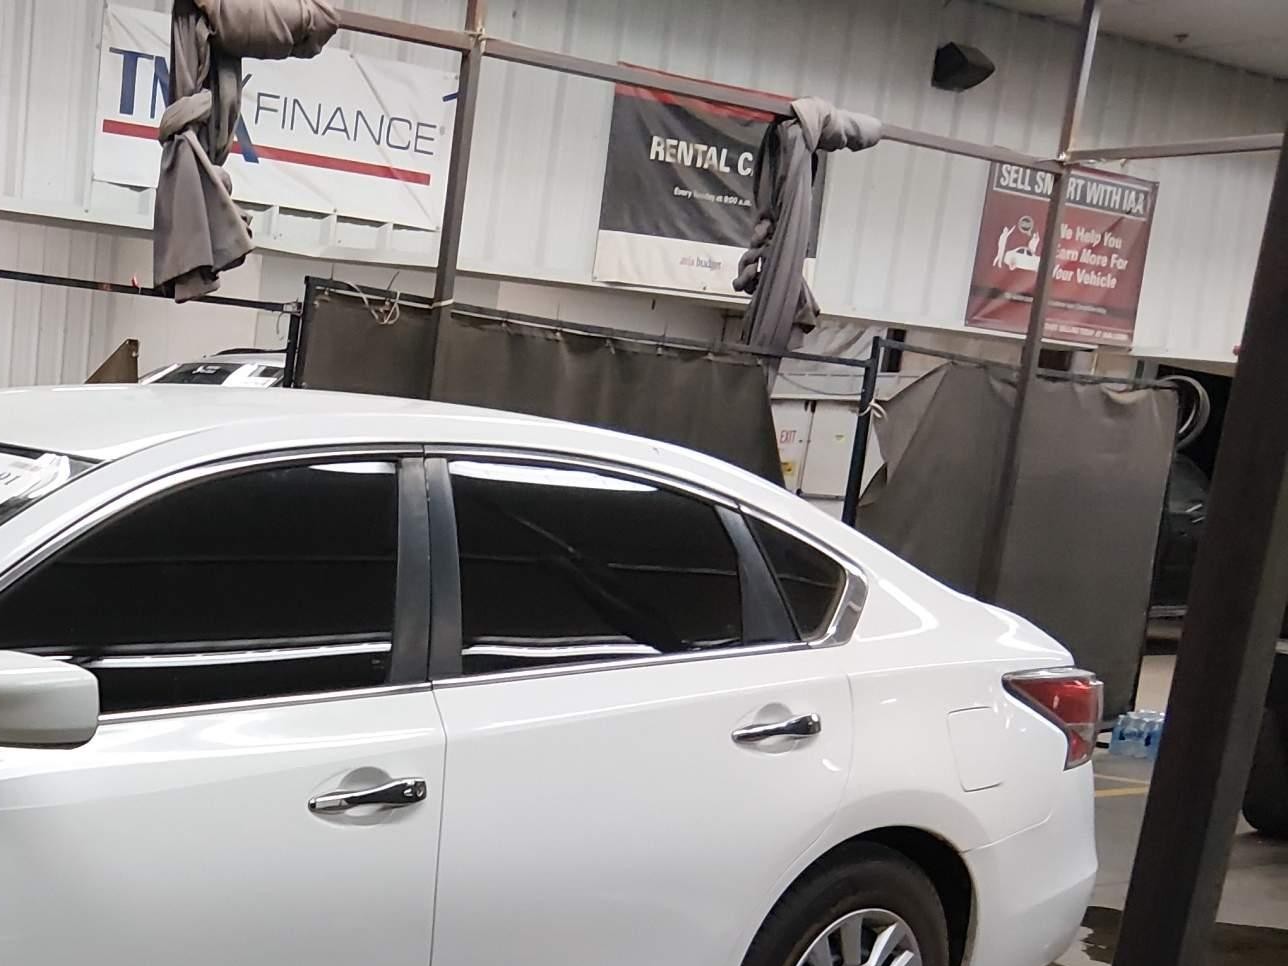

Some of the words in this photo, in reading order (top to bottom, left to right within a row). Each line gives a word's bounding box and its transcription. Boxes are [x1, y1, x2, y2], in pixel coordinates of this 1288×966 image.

[253, 92, 437, 156] FINANCE
[649, 135, 731, 173] RENTAL
[999, 164, 1032, 191] SELL
[1085, 181, 1122, 210] WITH
[1121, 188, 1146, 215] IAA
[1075, 226, 1102, 247] Help
[1103, 231, 1123, 249] You
[1079, 248, 1108, 267] More
[1110, 254, 1129, 270] For
[1076, 267, 1117, 289] Vehicle
[779, 430, 798, 444] EXIT
